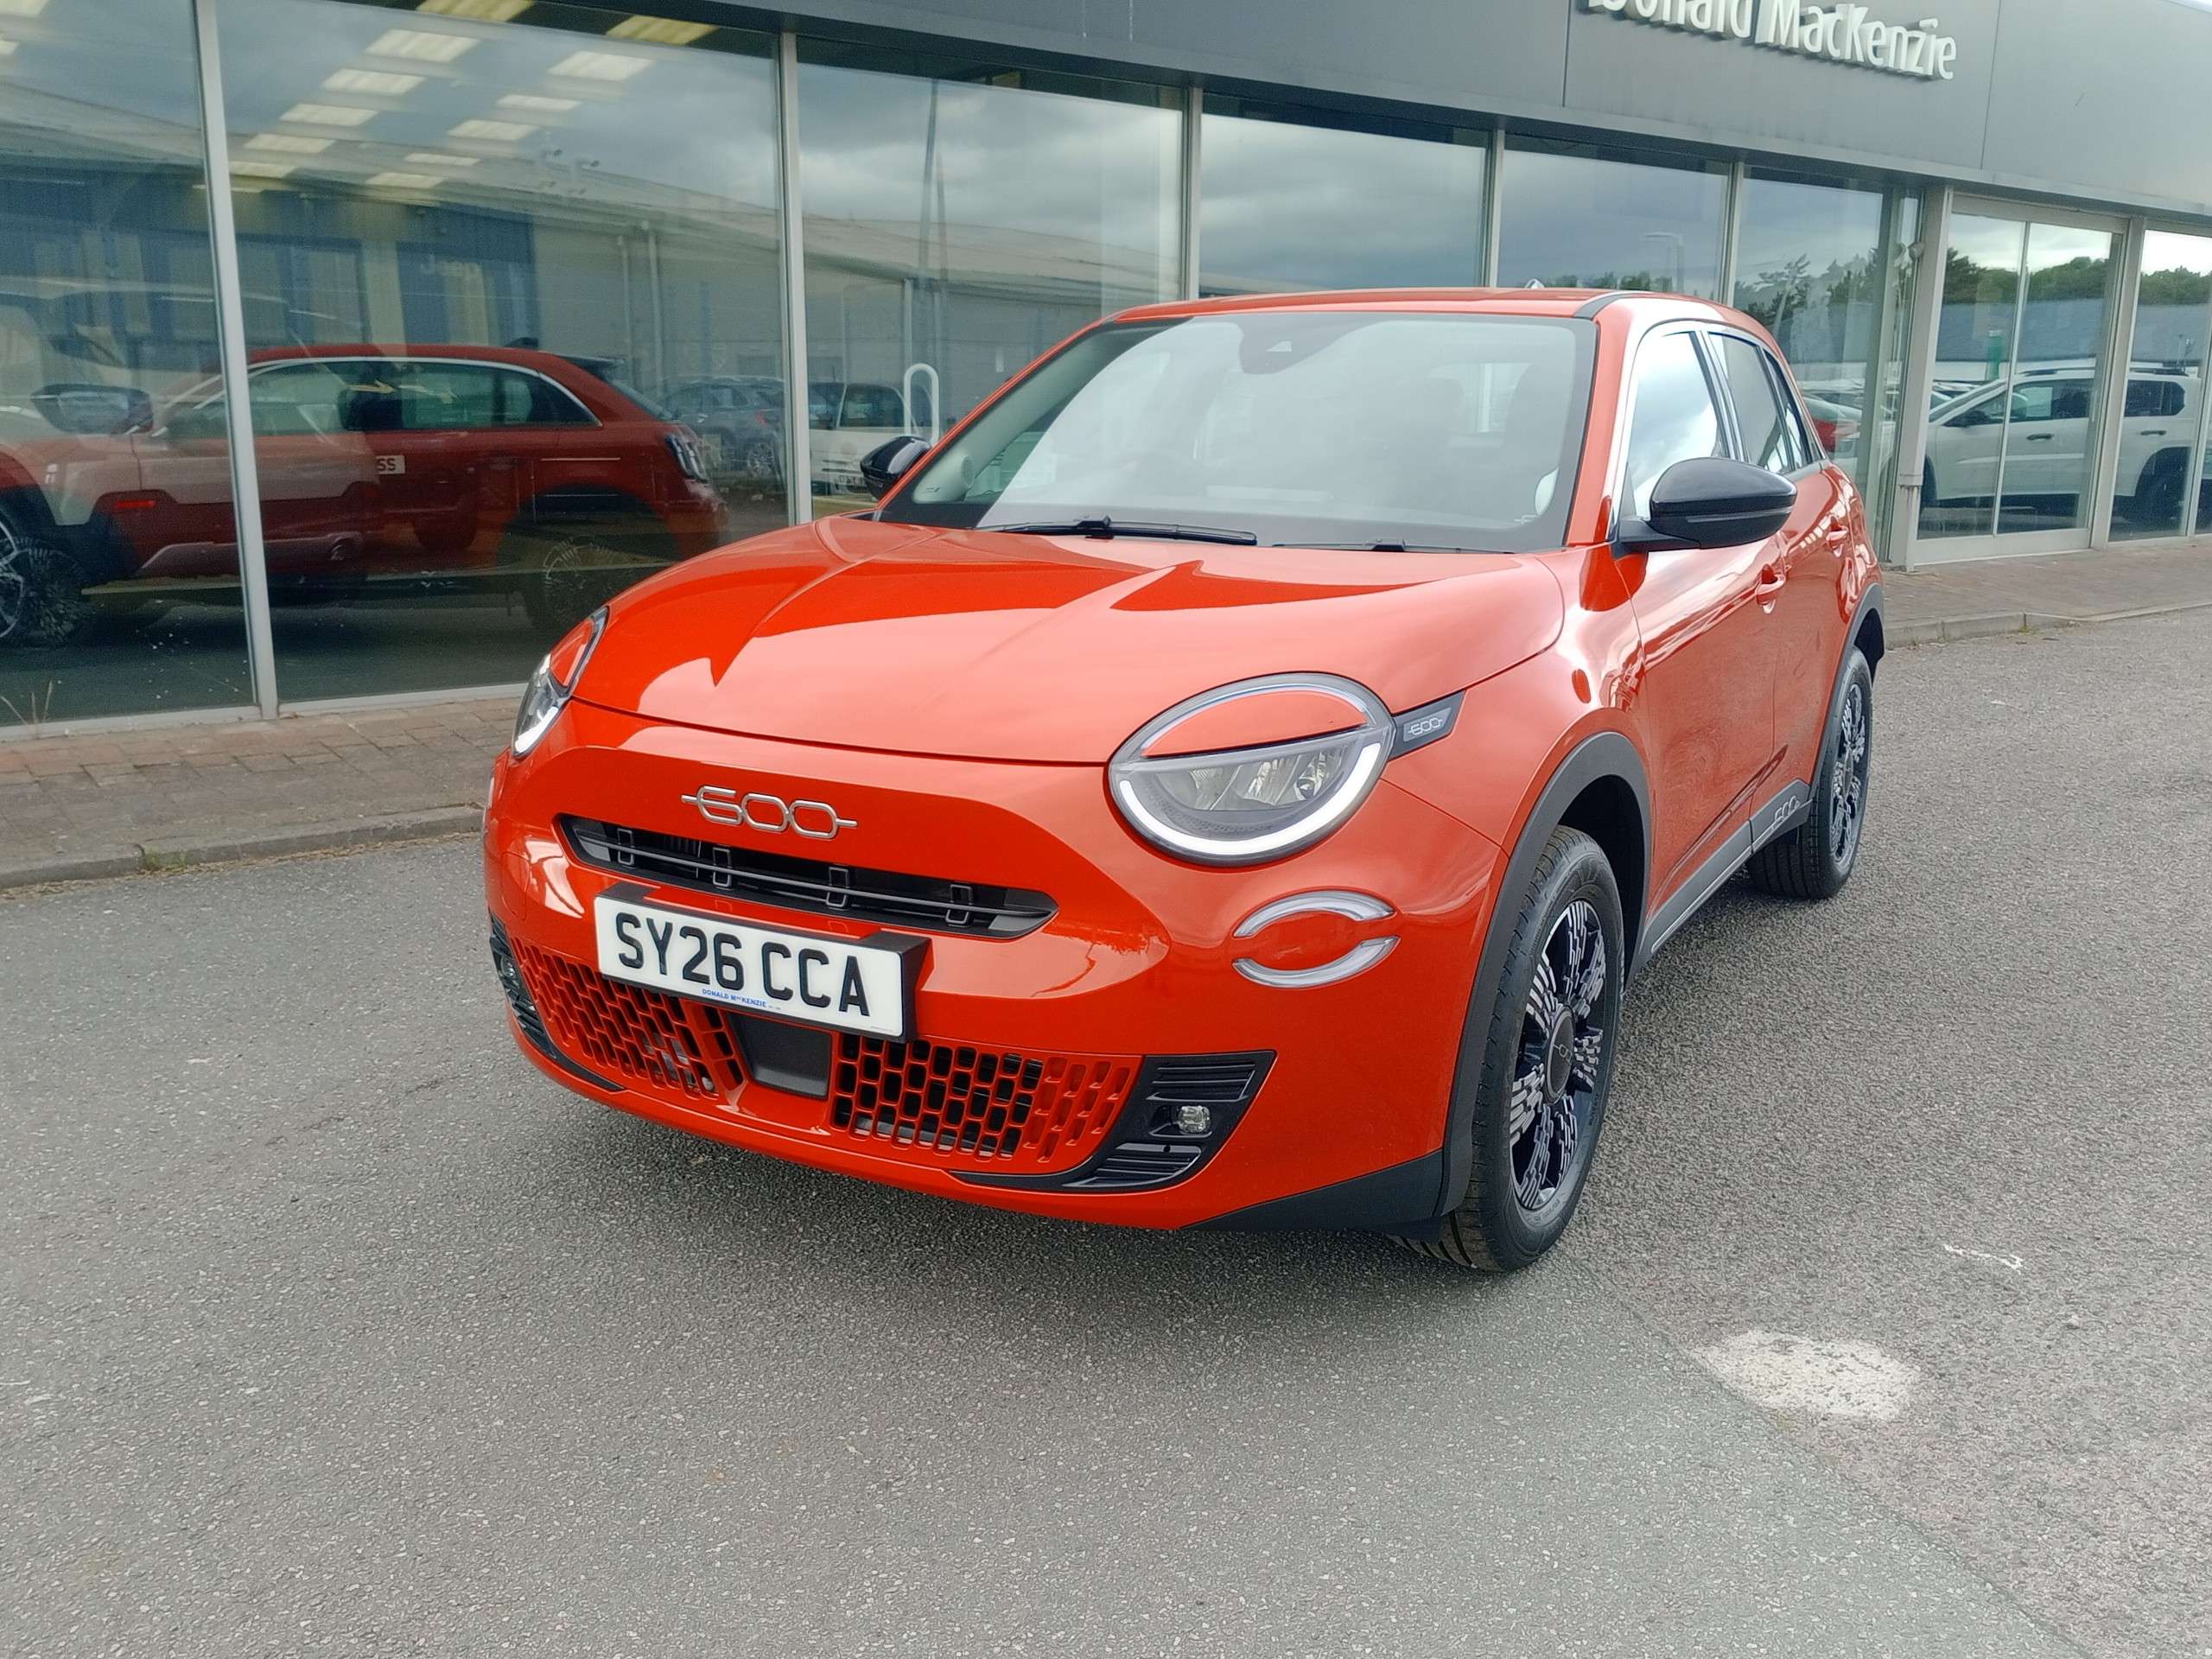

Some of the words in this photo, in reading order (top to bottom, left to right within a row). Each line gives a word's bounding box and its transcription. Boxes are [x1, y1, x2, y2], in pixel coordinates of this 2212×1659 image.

[1588, 0, 1753, 38] ald
[1755, 0, 1957, 79] MacKenzie
[1408, 717, 1443, 736] 600
[681, 785, 858, 840] 600
[615, 912, 745, 991] SY26
[760, 941, 870, 1017] CCA
